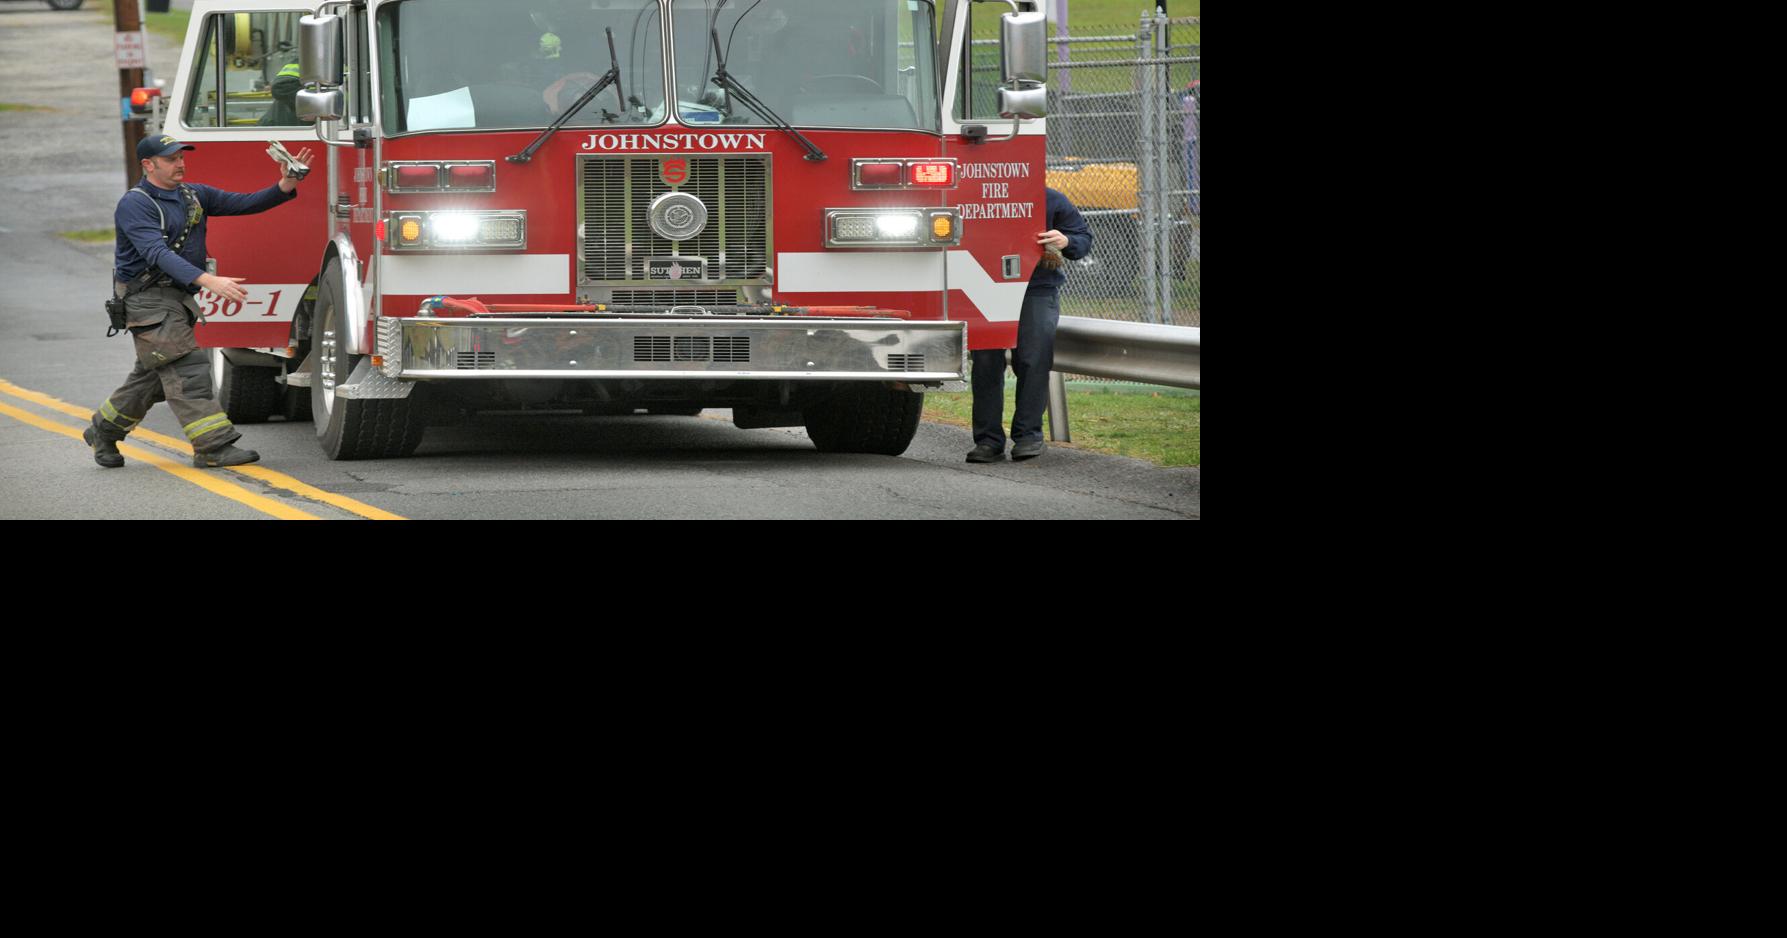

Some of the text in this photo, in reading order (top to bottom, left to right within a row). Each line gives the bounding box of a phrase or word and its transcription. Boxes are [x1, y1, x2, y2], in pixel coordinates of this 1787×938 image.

[581, 133, 767, 150] JOHNSTOWN
[960, 162, 1030, 179] JOHNSTOWN
[982, 182, 1009, 199] FIRE
[957, 202, 1034, 219] DEPARTMENT
[650, 266, 701, 275] SUTHEN
[199, 289, 282, 317] 36-1
